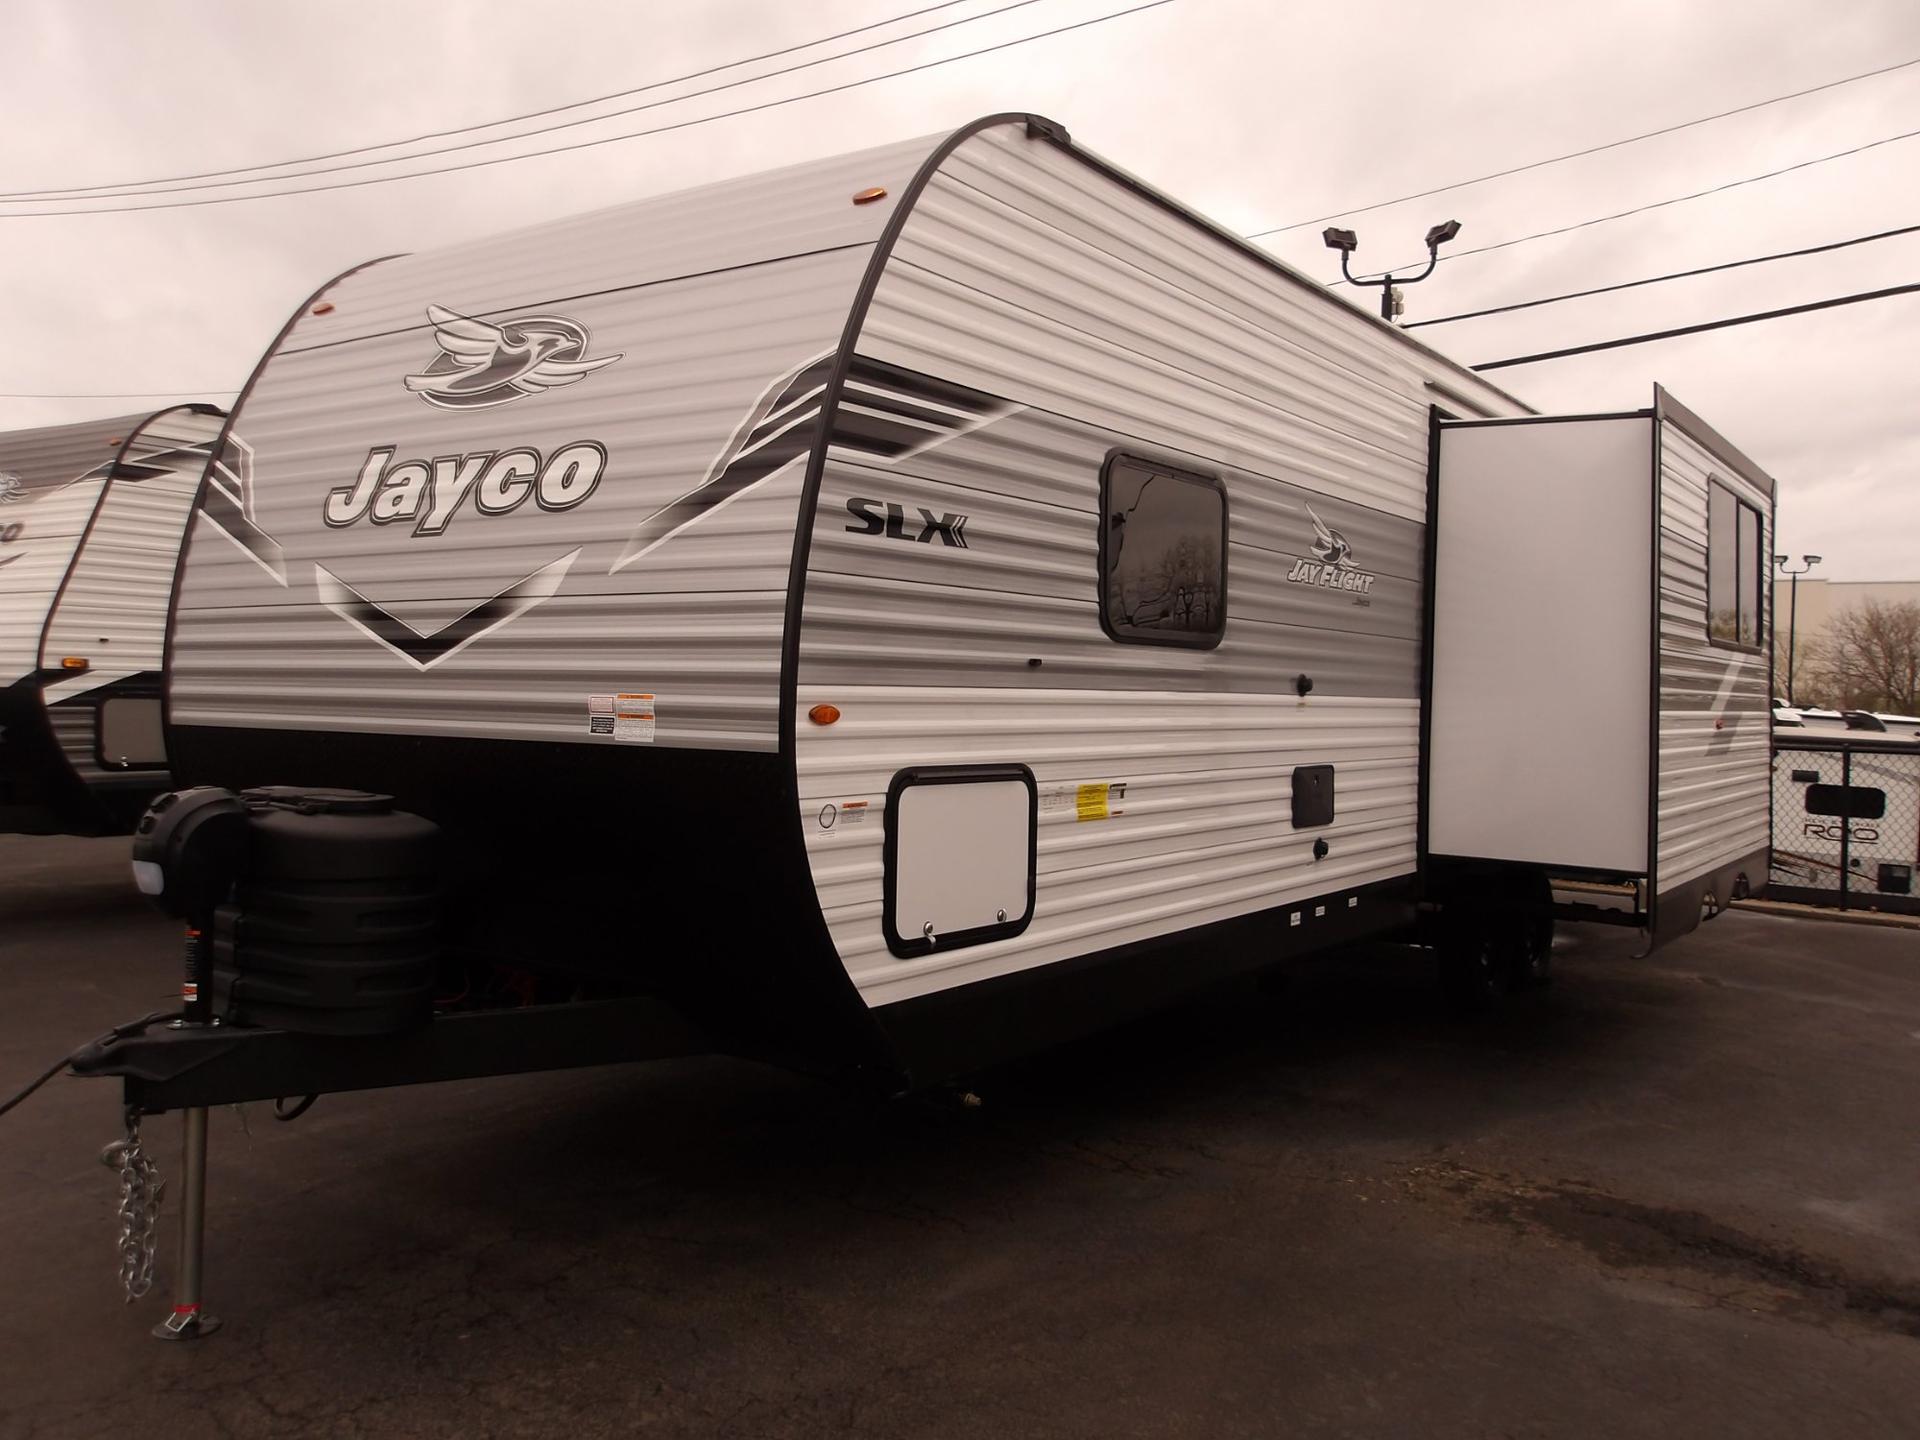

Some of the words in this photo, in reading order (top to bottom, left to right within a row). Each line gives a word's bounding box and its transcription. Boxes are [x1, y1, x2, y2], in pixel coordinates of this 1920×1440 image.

[323, 440, 608, 537] Jayco
[845, 497, 968, 548] SLX
[1287, 558, 1321, 584] JAY
[1319, 564, 1375, 594] FLIGHT
